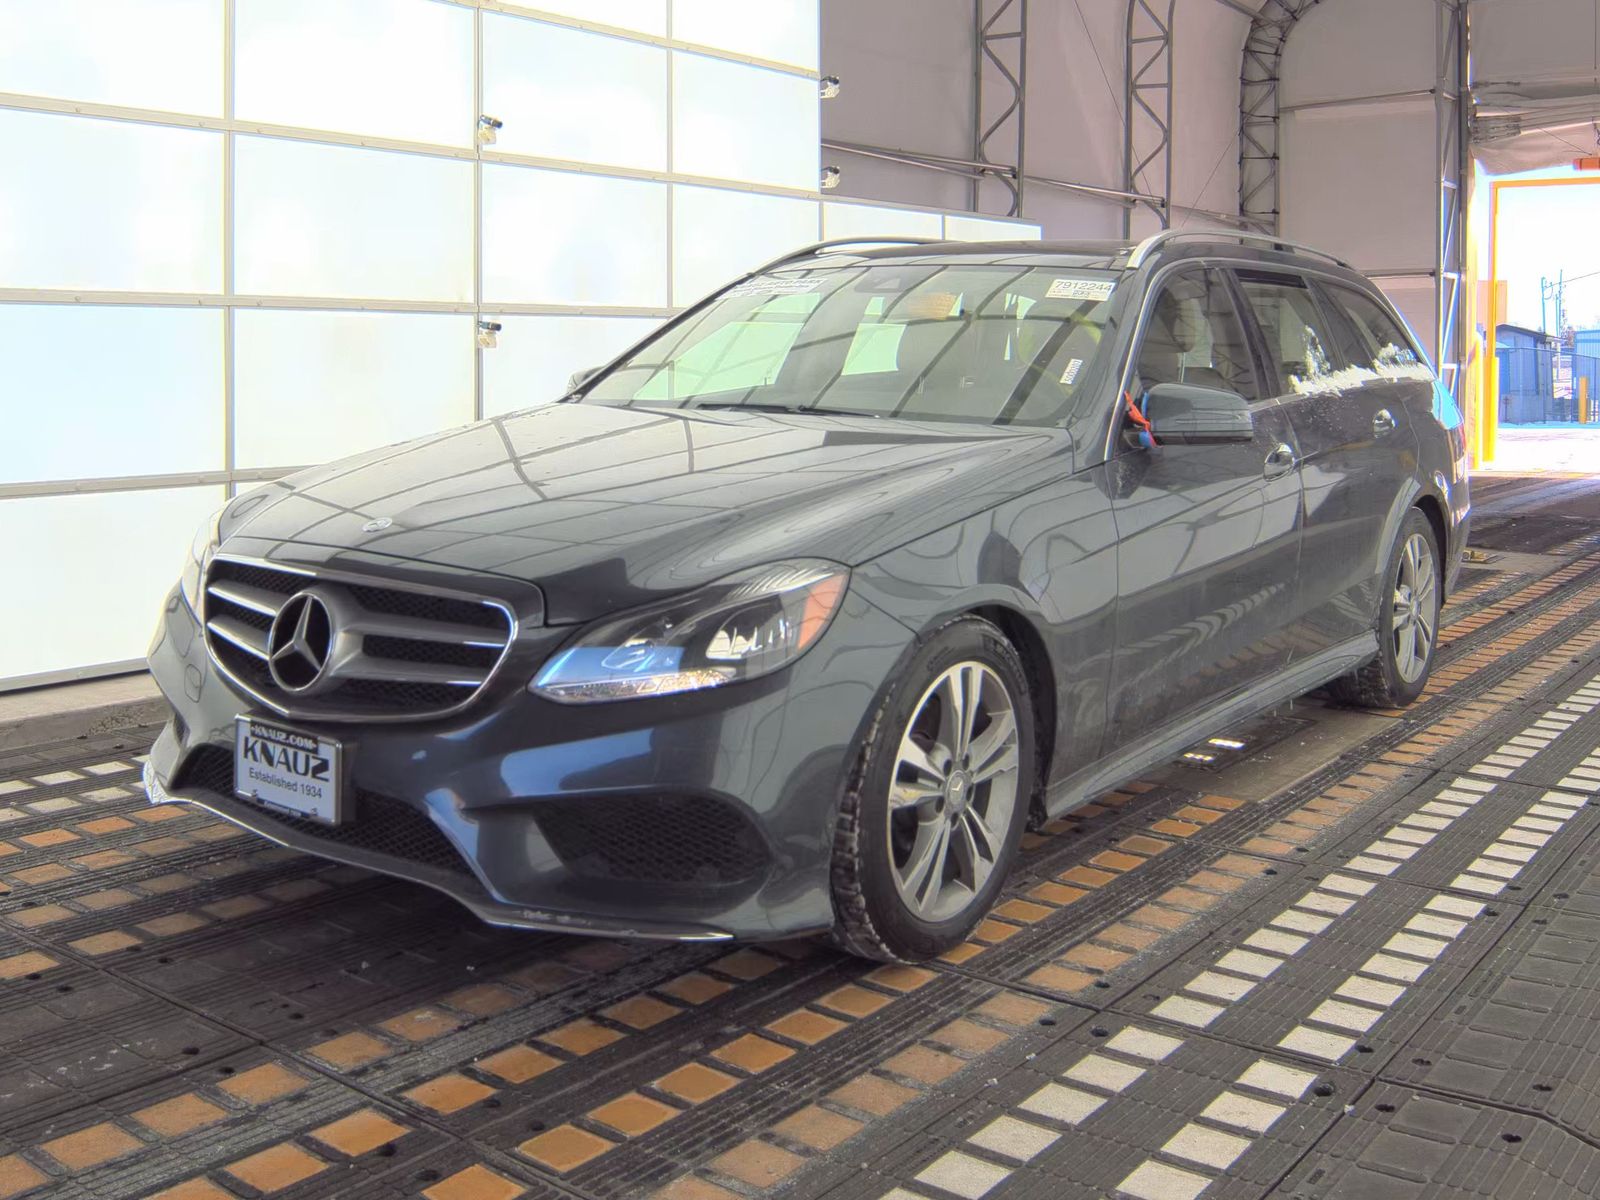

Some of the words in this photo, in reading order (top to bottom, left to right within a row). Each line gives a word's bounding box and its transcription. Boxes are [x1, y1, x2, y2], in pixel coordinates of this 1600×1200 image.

[1055, 281, 1113, 291] 7912244
[243, 736, 330, 783] KNAUZ
[249, 767, 298, 792] Established
[301, 783, 323, 799] 1934
